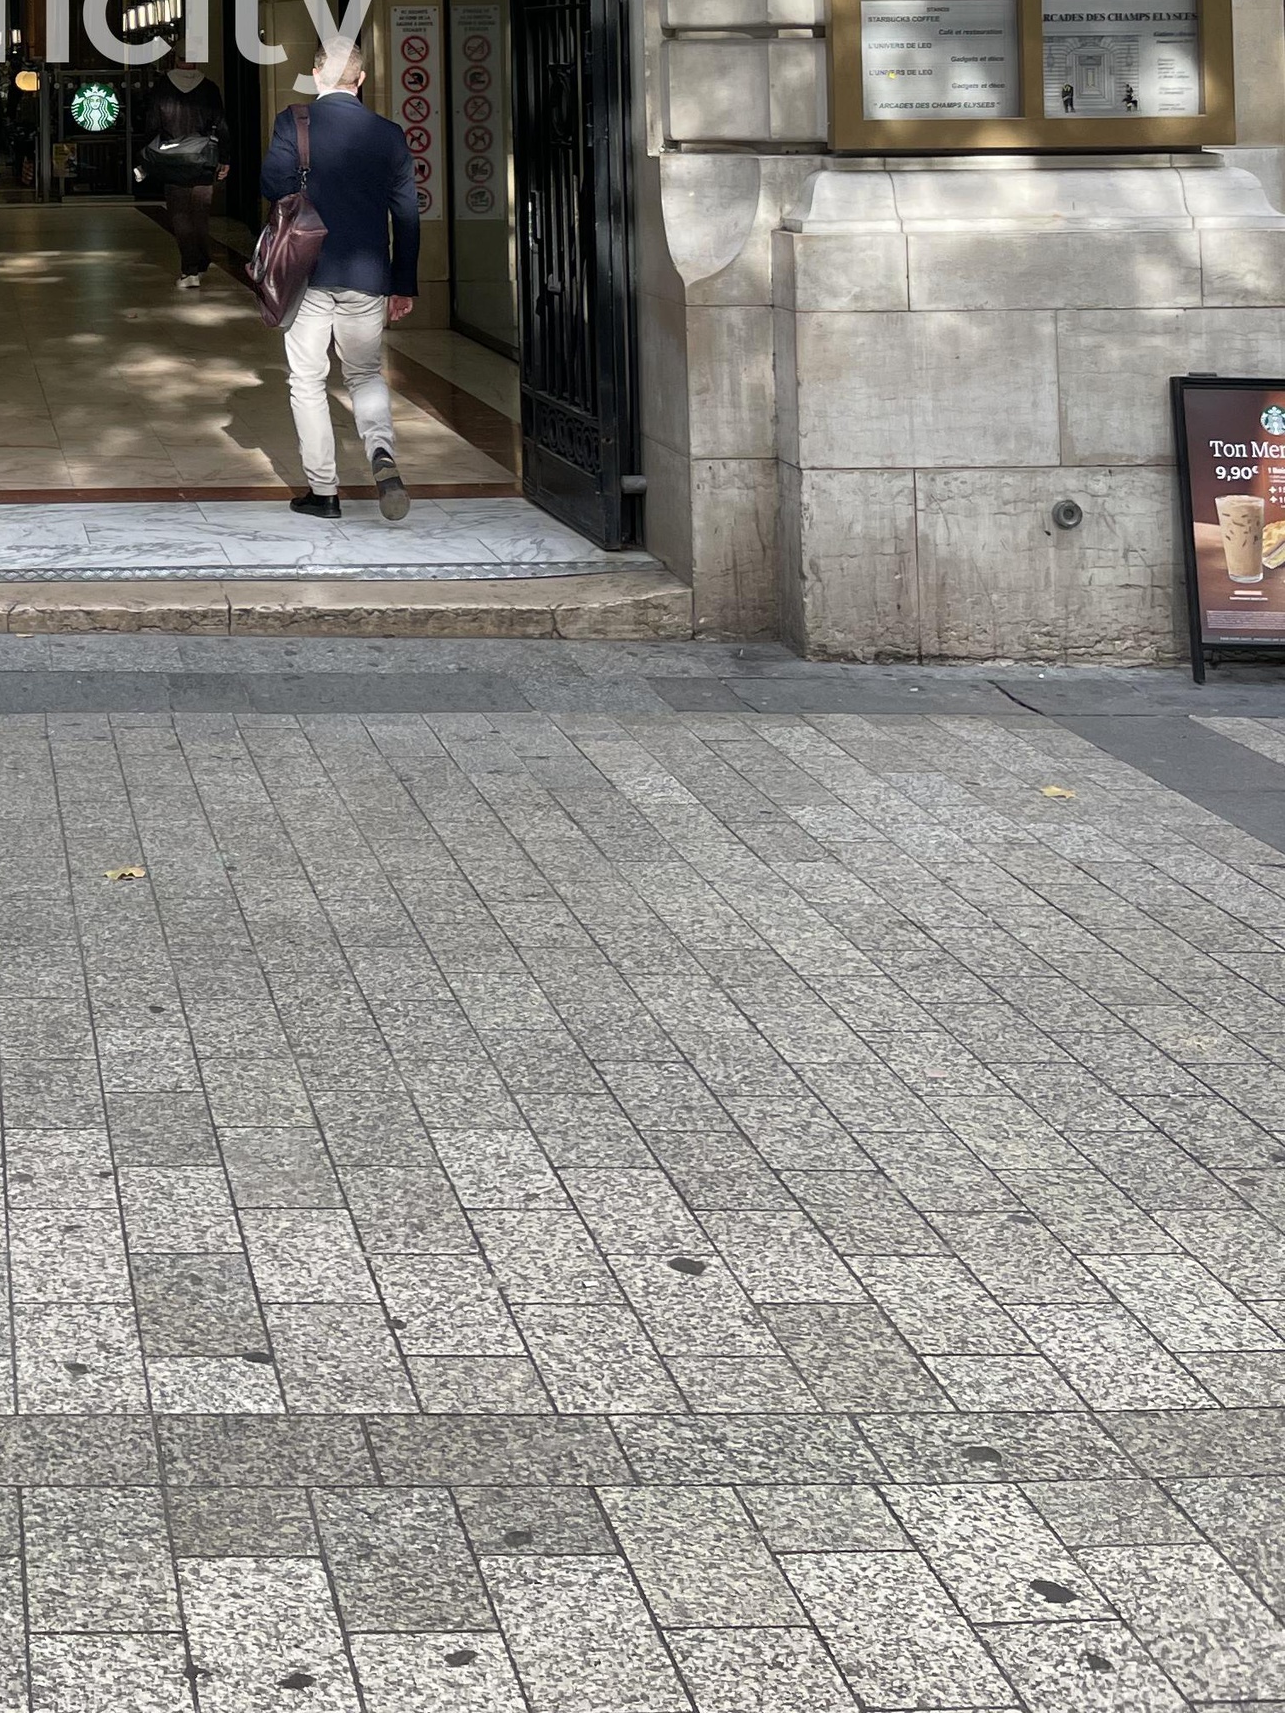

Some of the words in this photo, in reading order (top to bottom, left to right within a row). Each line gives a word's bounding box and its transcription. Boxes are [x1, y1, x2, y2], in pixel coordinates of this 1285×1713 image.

[1086, 13, 1106, 22] DES
[1107, 12, 1151, 22] CHAMPS
[1209, 440, 1248, 458] Ton
[1215, 465, 1259, 482] 9,90€
